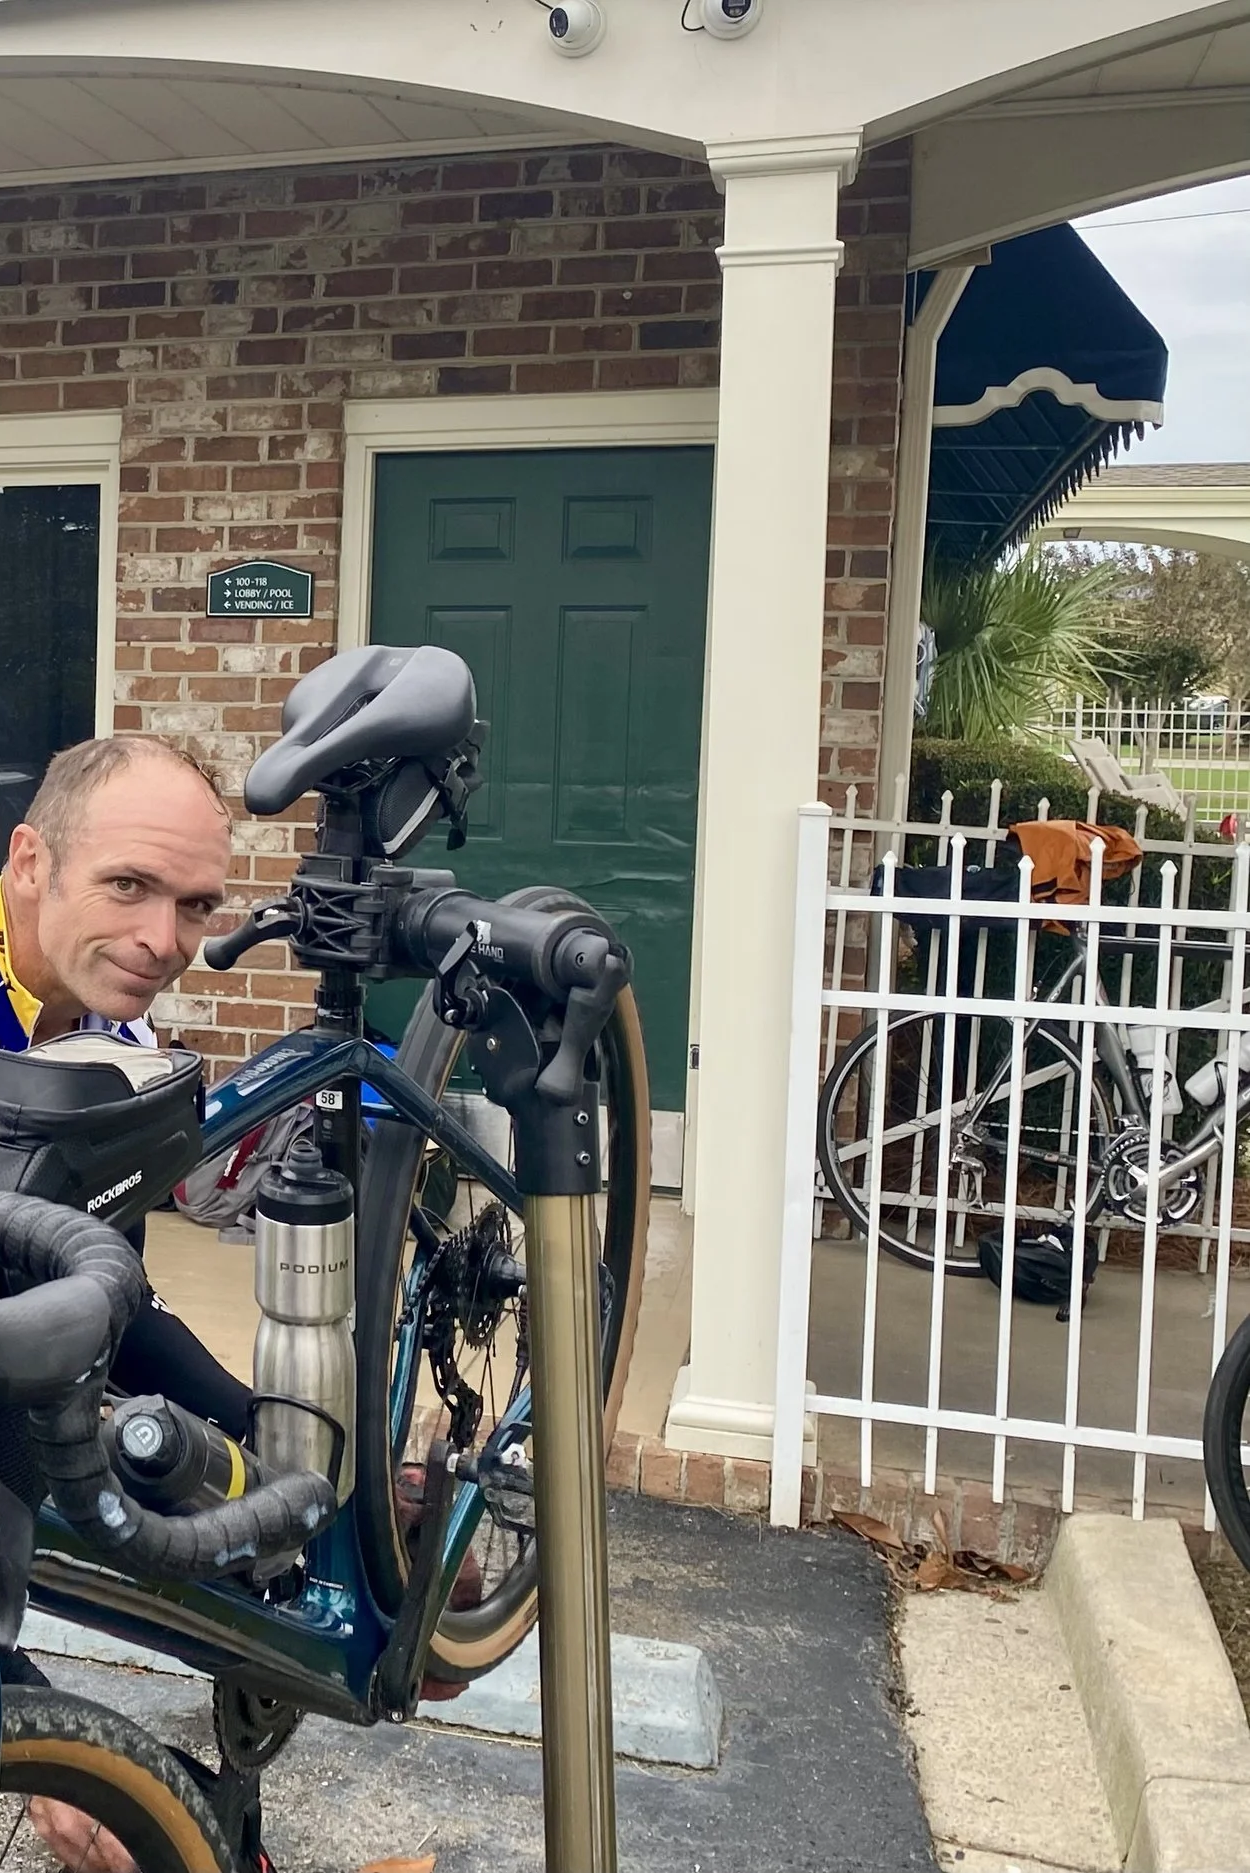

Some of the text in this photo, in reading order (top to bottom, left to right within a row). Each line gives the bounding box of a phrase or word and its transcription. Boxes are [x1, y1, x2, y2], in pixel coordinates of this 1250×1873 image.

[234, 588, 261, 598] LOBBY
[269, 588, 292, 598] POOL
[234, 600, 272, 609] VENDING
[280, 600, 294, 609] ICE
[478, 943, 504, 959] HAND
[321, 1092, 335, 1105] 58
[87, 1170, 143, 1214] ROCKBROS
[279, 1258, 350, 1275] PODIUM
